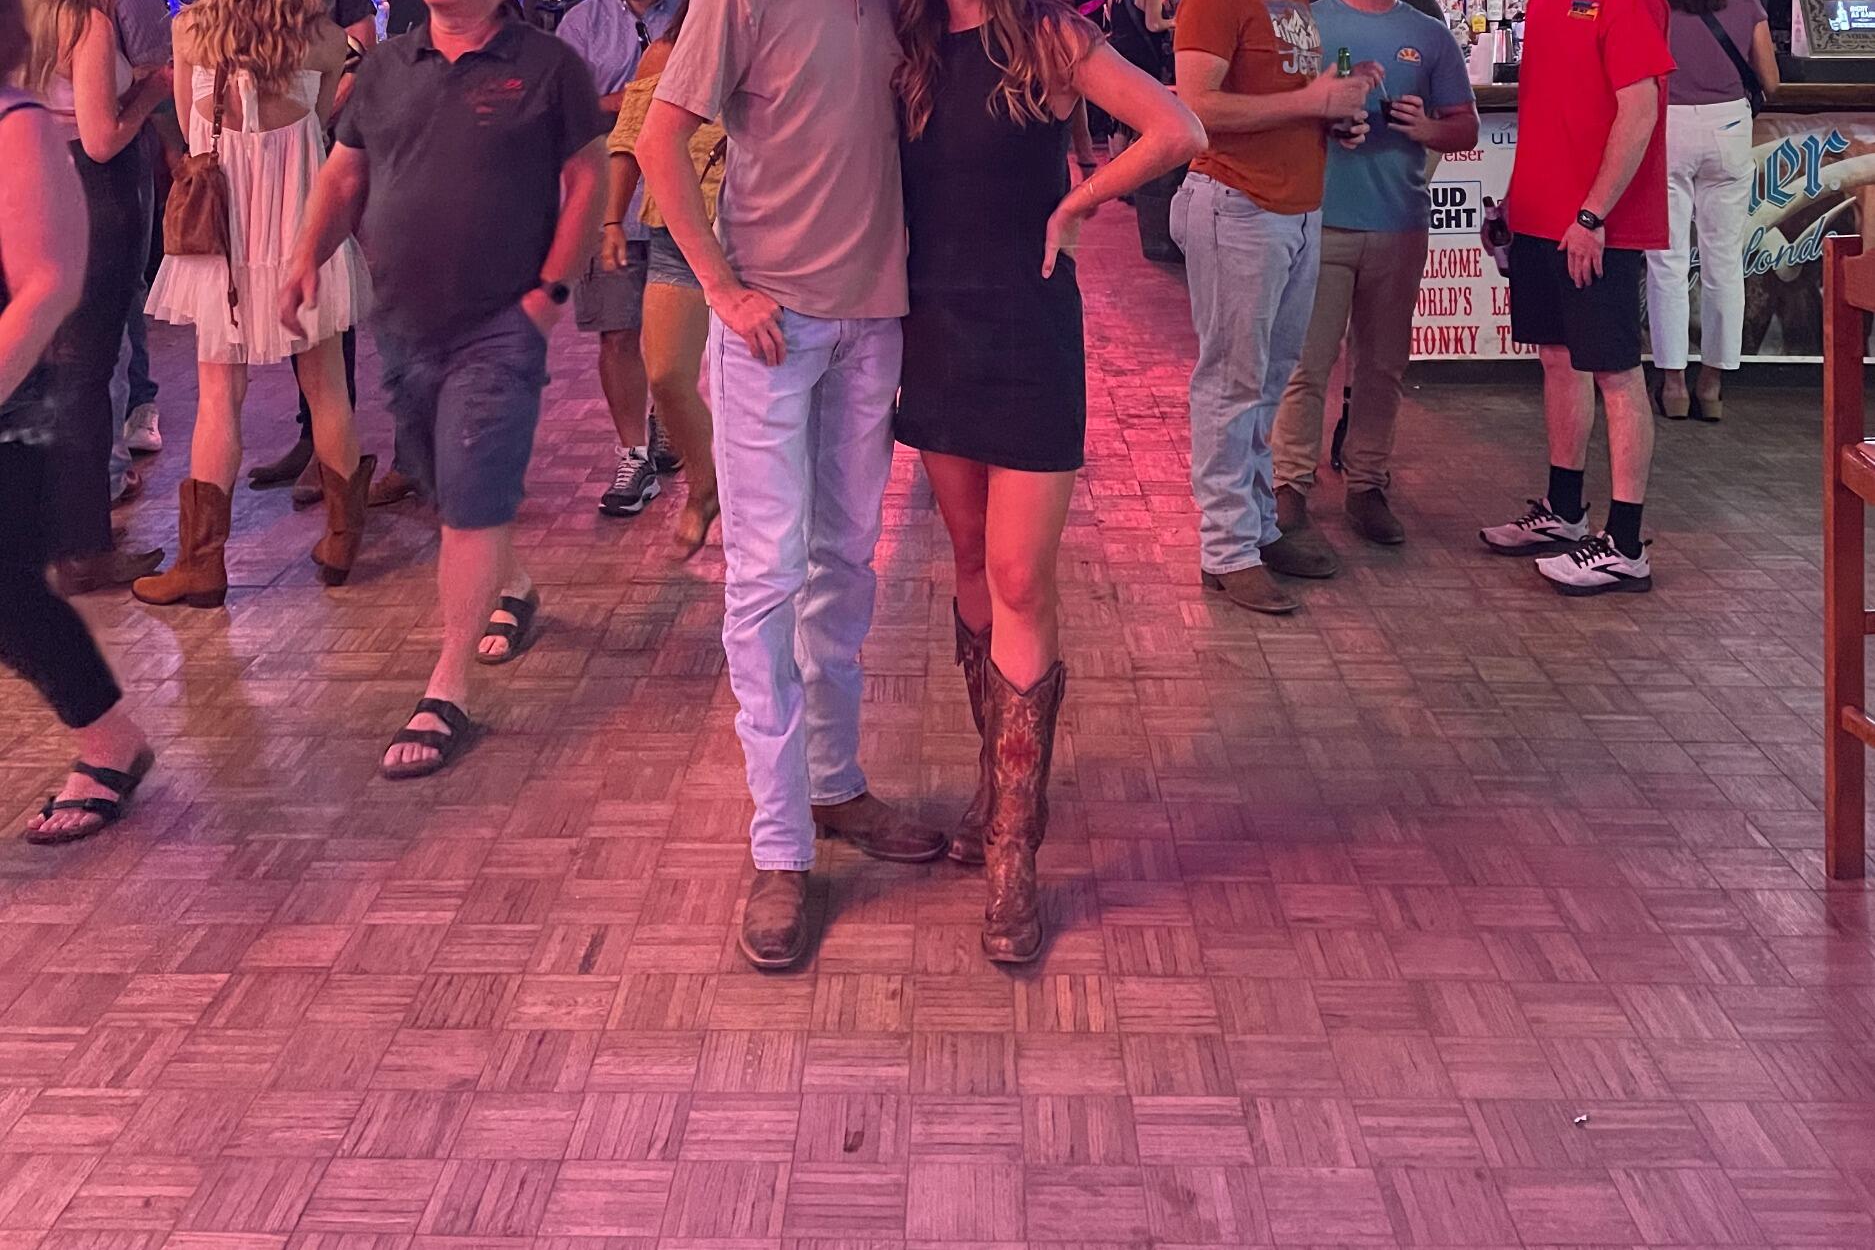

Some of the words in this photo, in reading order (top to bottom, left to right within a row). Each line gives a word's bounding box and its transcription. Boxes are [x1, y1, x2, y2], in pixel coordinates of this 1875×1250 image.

[1428, 187, 1467, 208] UD
[1430, 208, 1477, 229] GHT
[1744, 215, 1836, 278] lond
[1417, 286, 1472, 317] ORLD'S
[1411, 325, 1479, 355] HONKY
